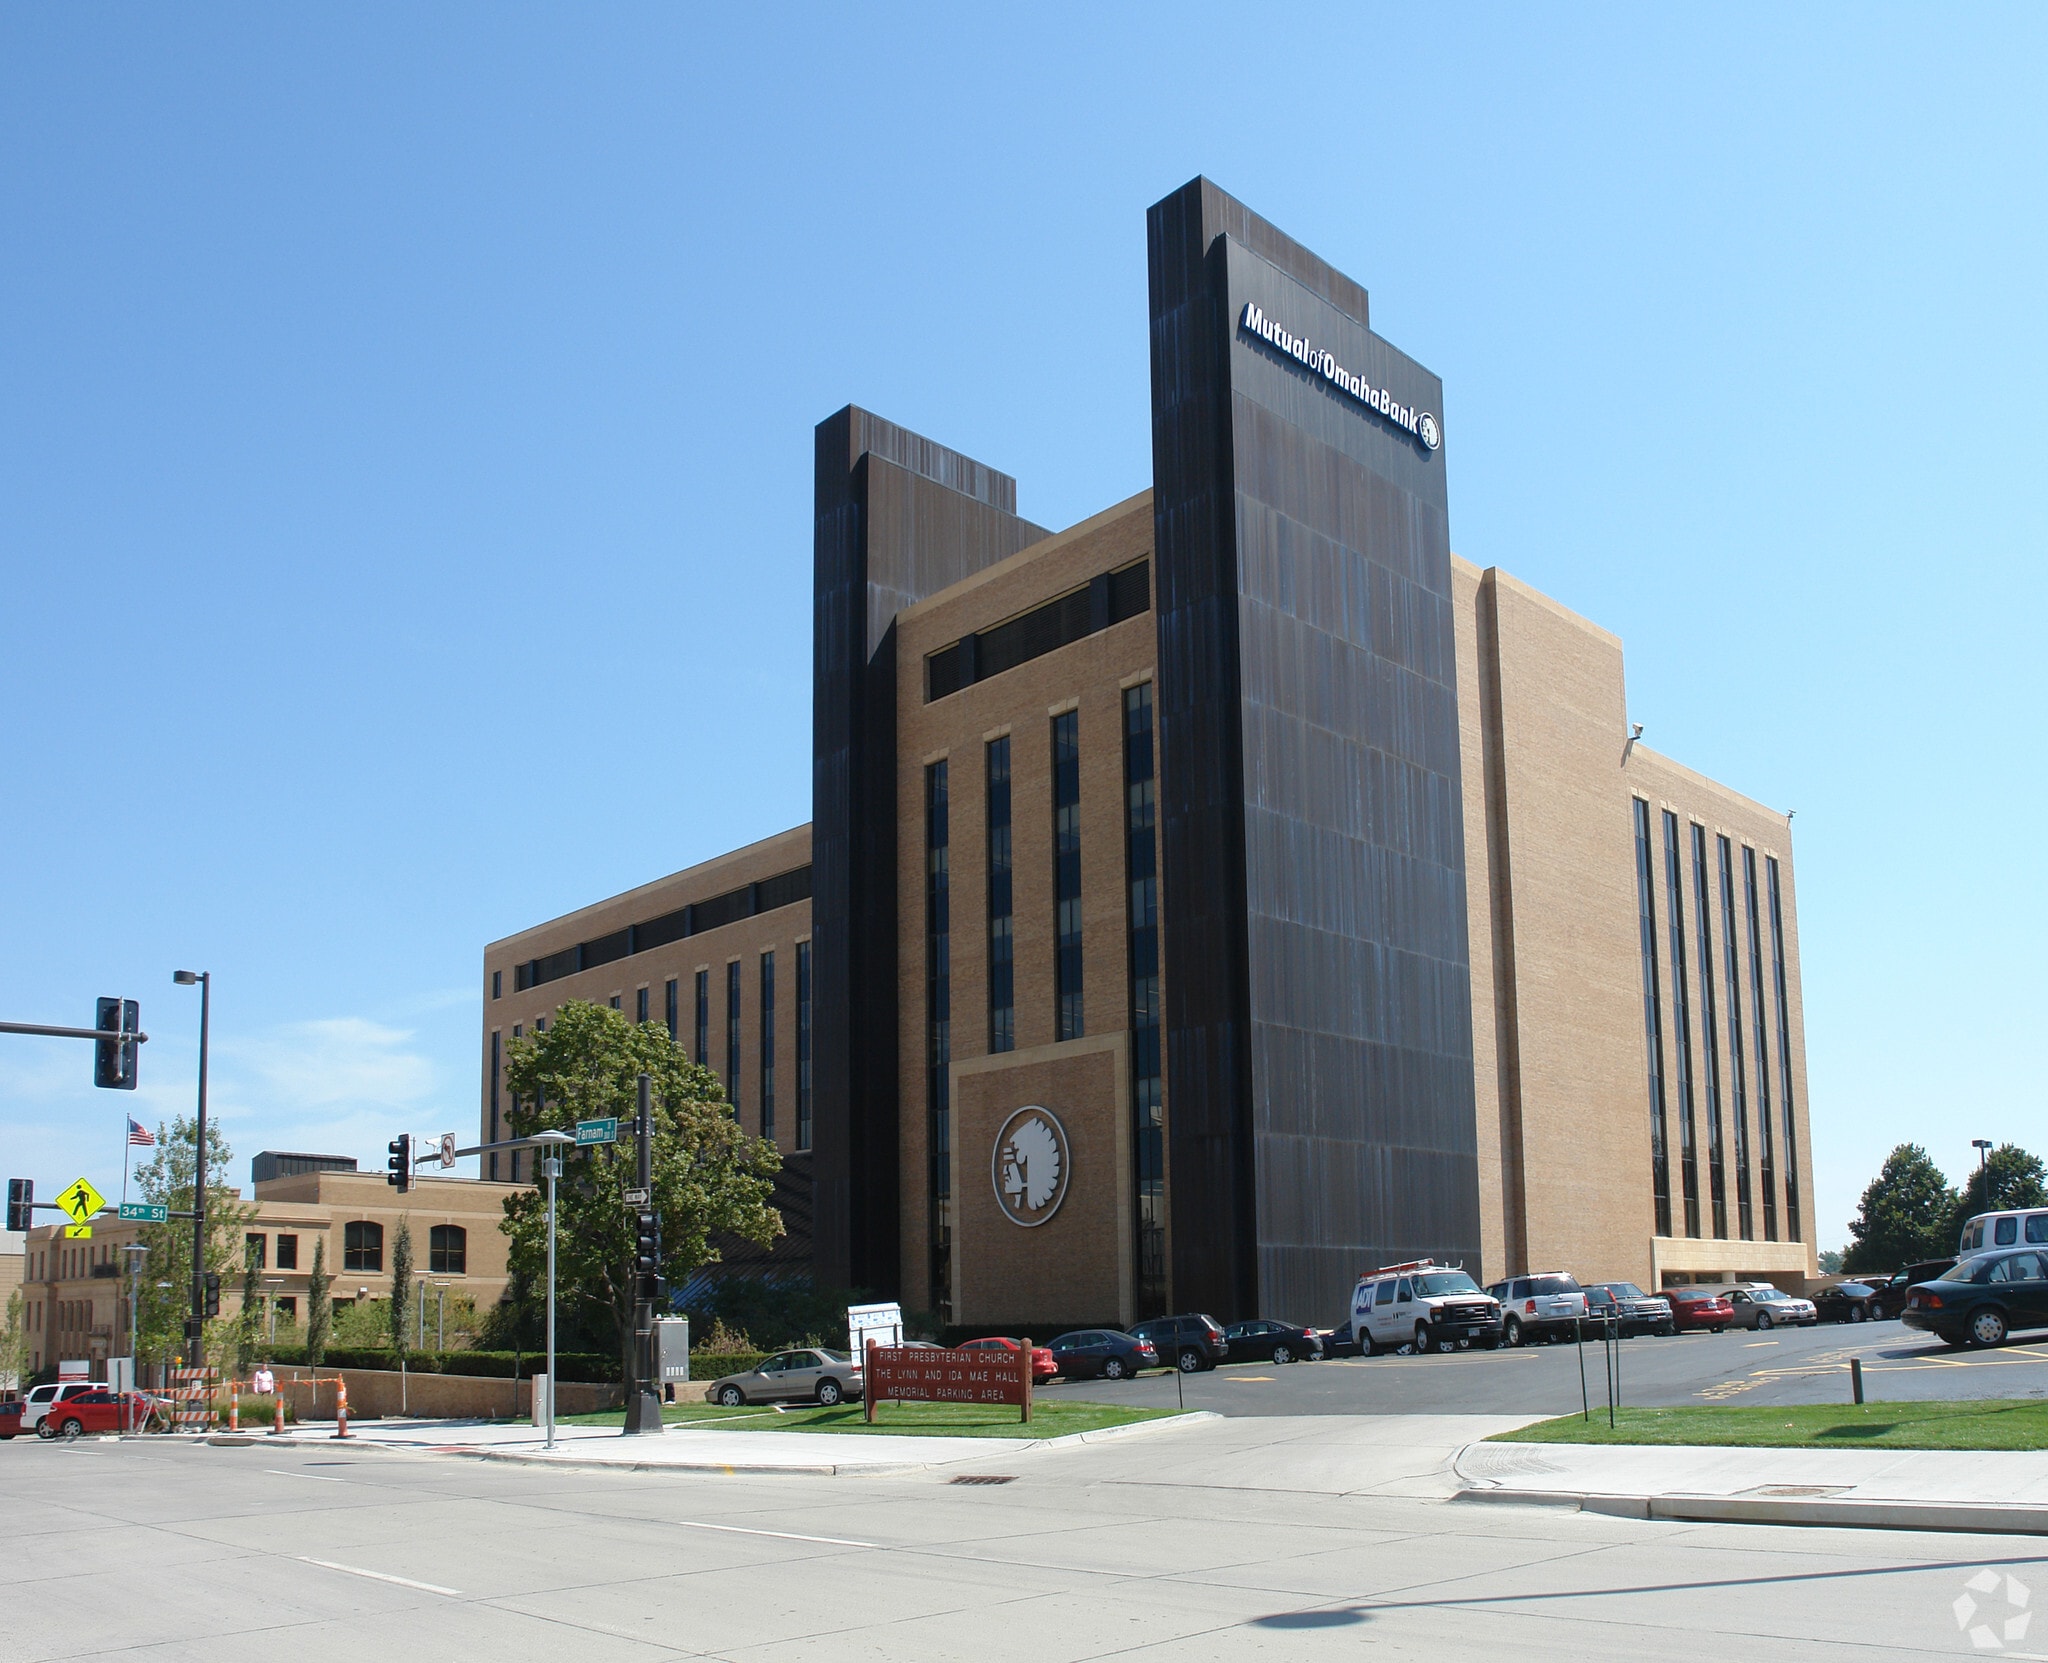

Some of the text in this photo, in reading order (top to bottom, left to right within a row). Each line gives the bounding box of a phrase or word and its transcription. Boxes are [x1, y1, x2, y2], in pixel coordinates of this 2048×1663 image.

[577, 1126, 604, 1140] Farnam
[121, 1206, 164, 1219] 34th St
[1356, 1286, 1374, 1308] ADT
[879, 1351, 1015, 1364] FIRST PRESBYTERIAN CHURCH
[875, 1368, 1019, 1383] THE LYNN AND IDA MAE HALL
[887, 1386, 1005, 1400] MEMORIAL PARKING AREA
